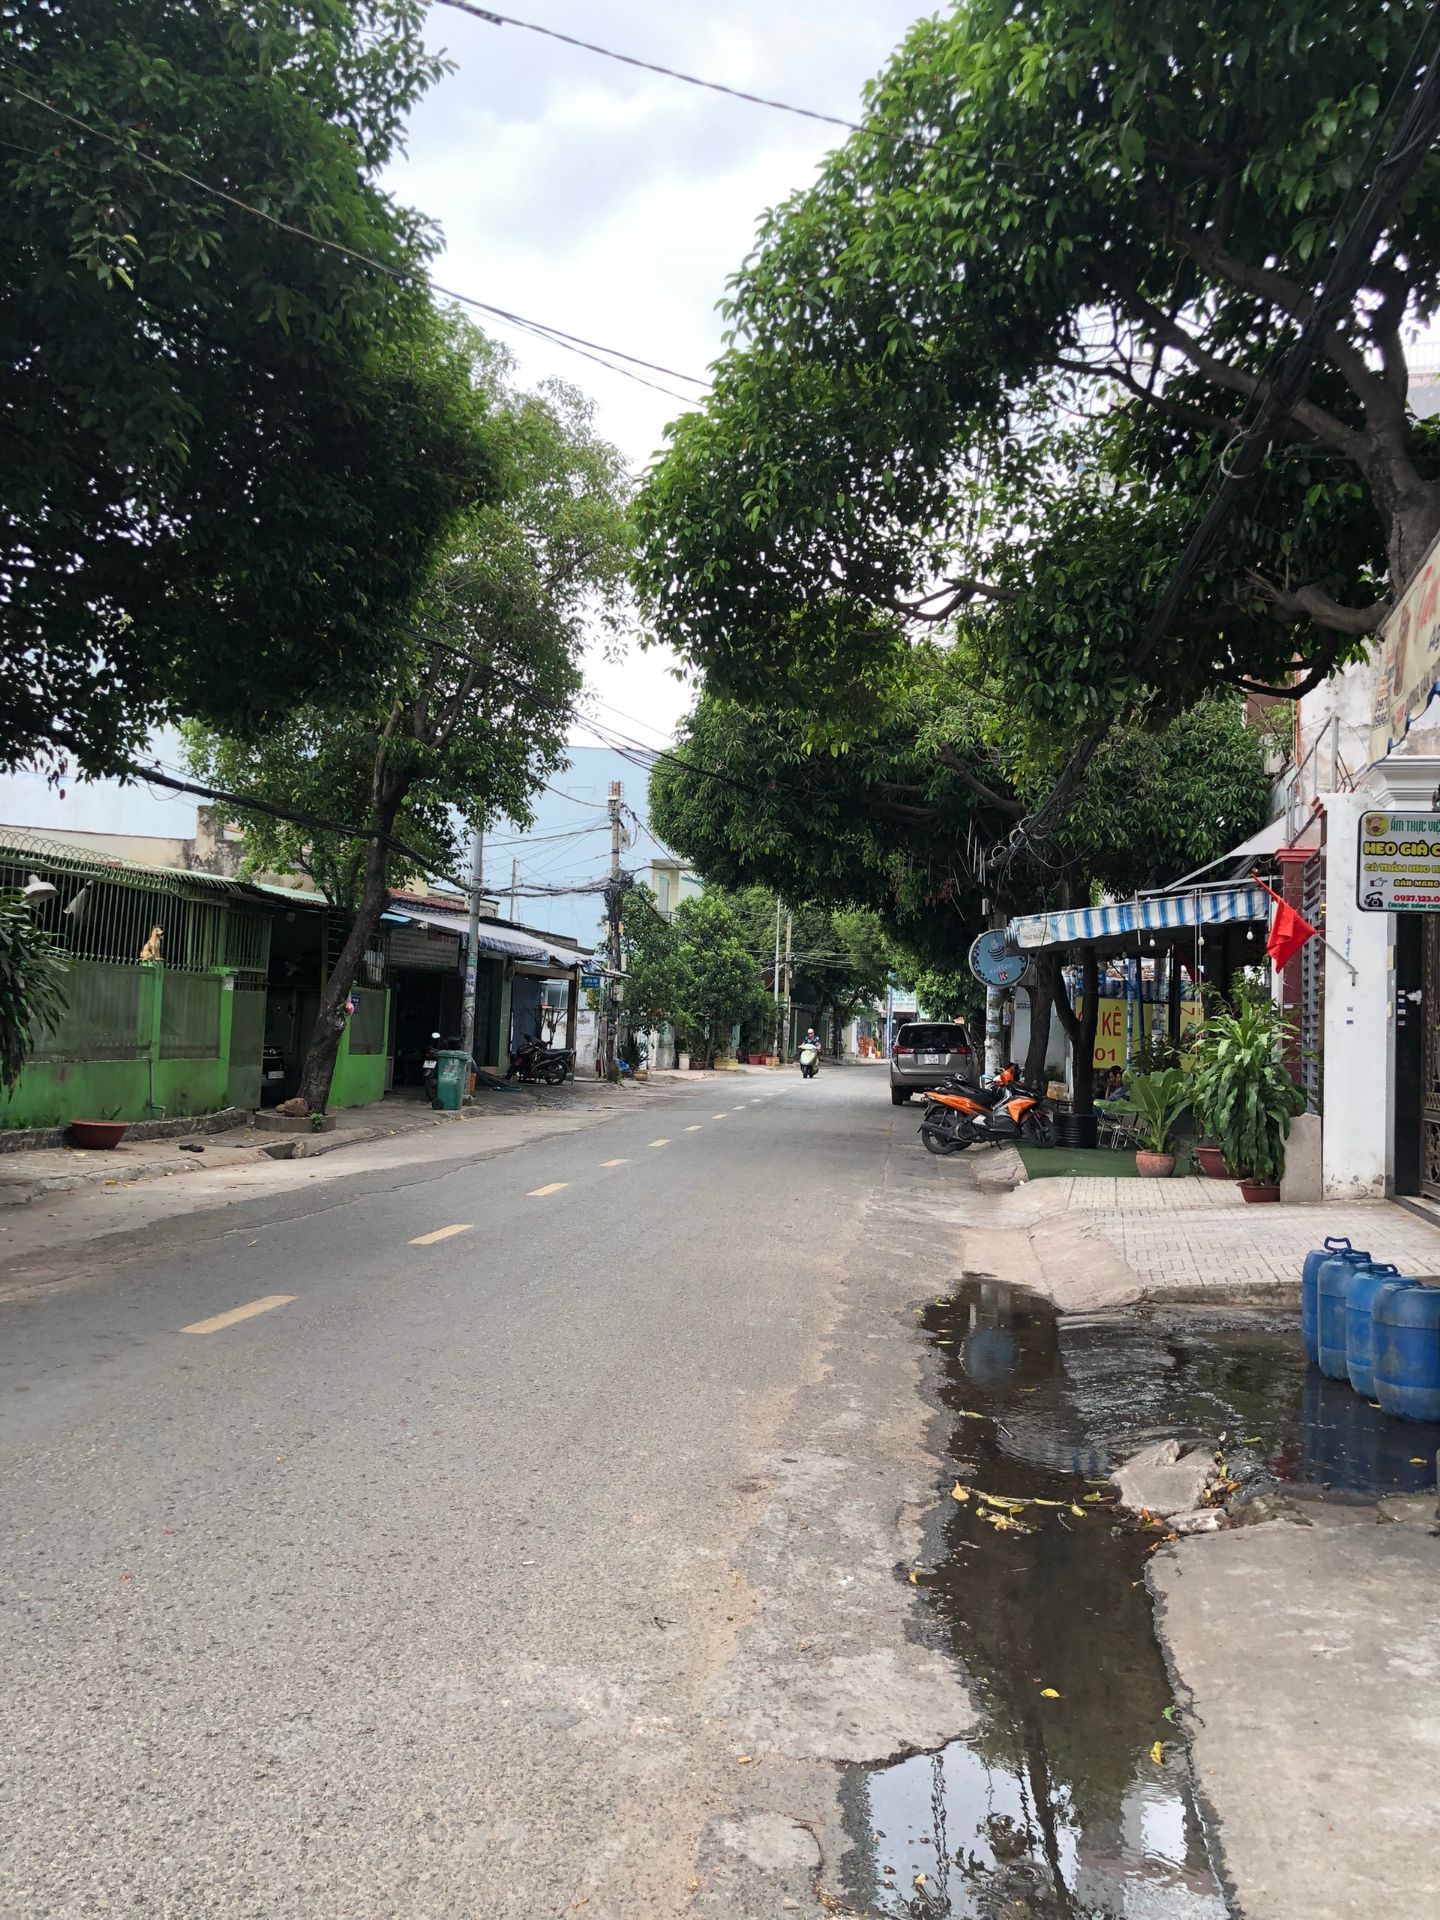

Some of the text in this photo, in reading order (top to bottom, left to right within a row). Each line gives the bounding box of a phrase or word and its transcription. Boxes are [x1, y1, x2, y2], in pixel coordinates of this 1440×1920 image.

[1406, 819, 1426, 835] THỰC
[1364, 841, 1397, 856] HEO
[1394, 878, 1412, 887] BÁN
[1102, 1006, 1122, 1037] KÊ
[1094, 1047, 1116, 1061] 01
